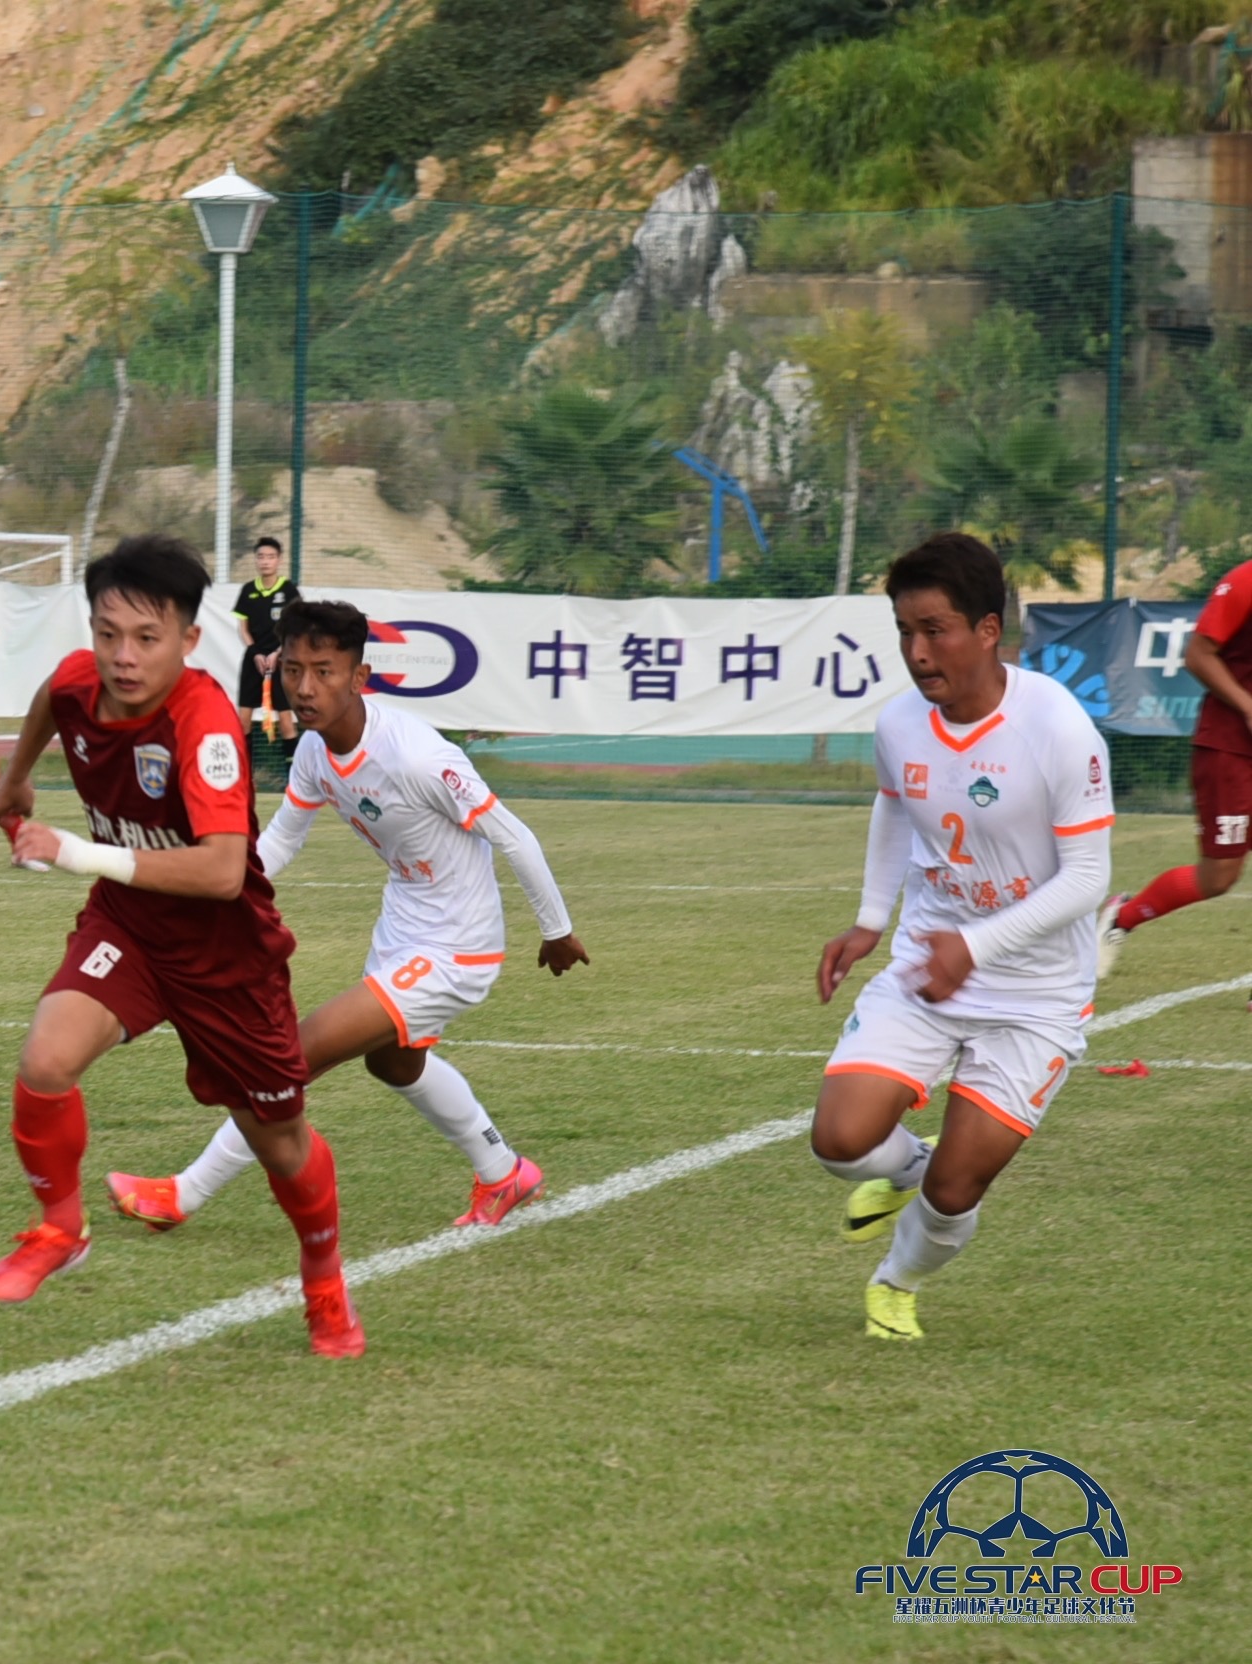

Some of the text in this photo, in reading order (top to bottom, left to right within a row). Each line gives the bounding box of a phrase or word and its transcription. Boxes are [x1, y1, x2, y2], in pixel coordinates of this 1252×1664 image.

[527, 629, 882, 702] 中智中心
[941, 812, 974, 865] 2
[80, 941, 123, 979] 6
[390, 956, 433, 990] 8
[1029, 1056, 1065, 1108] 2
